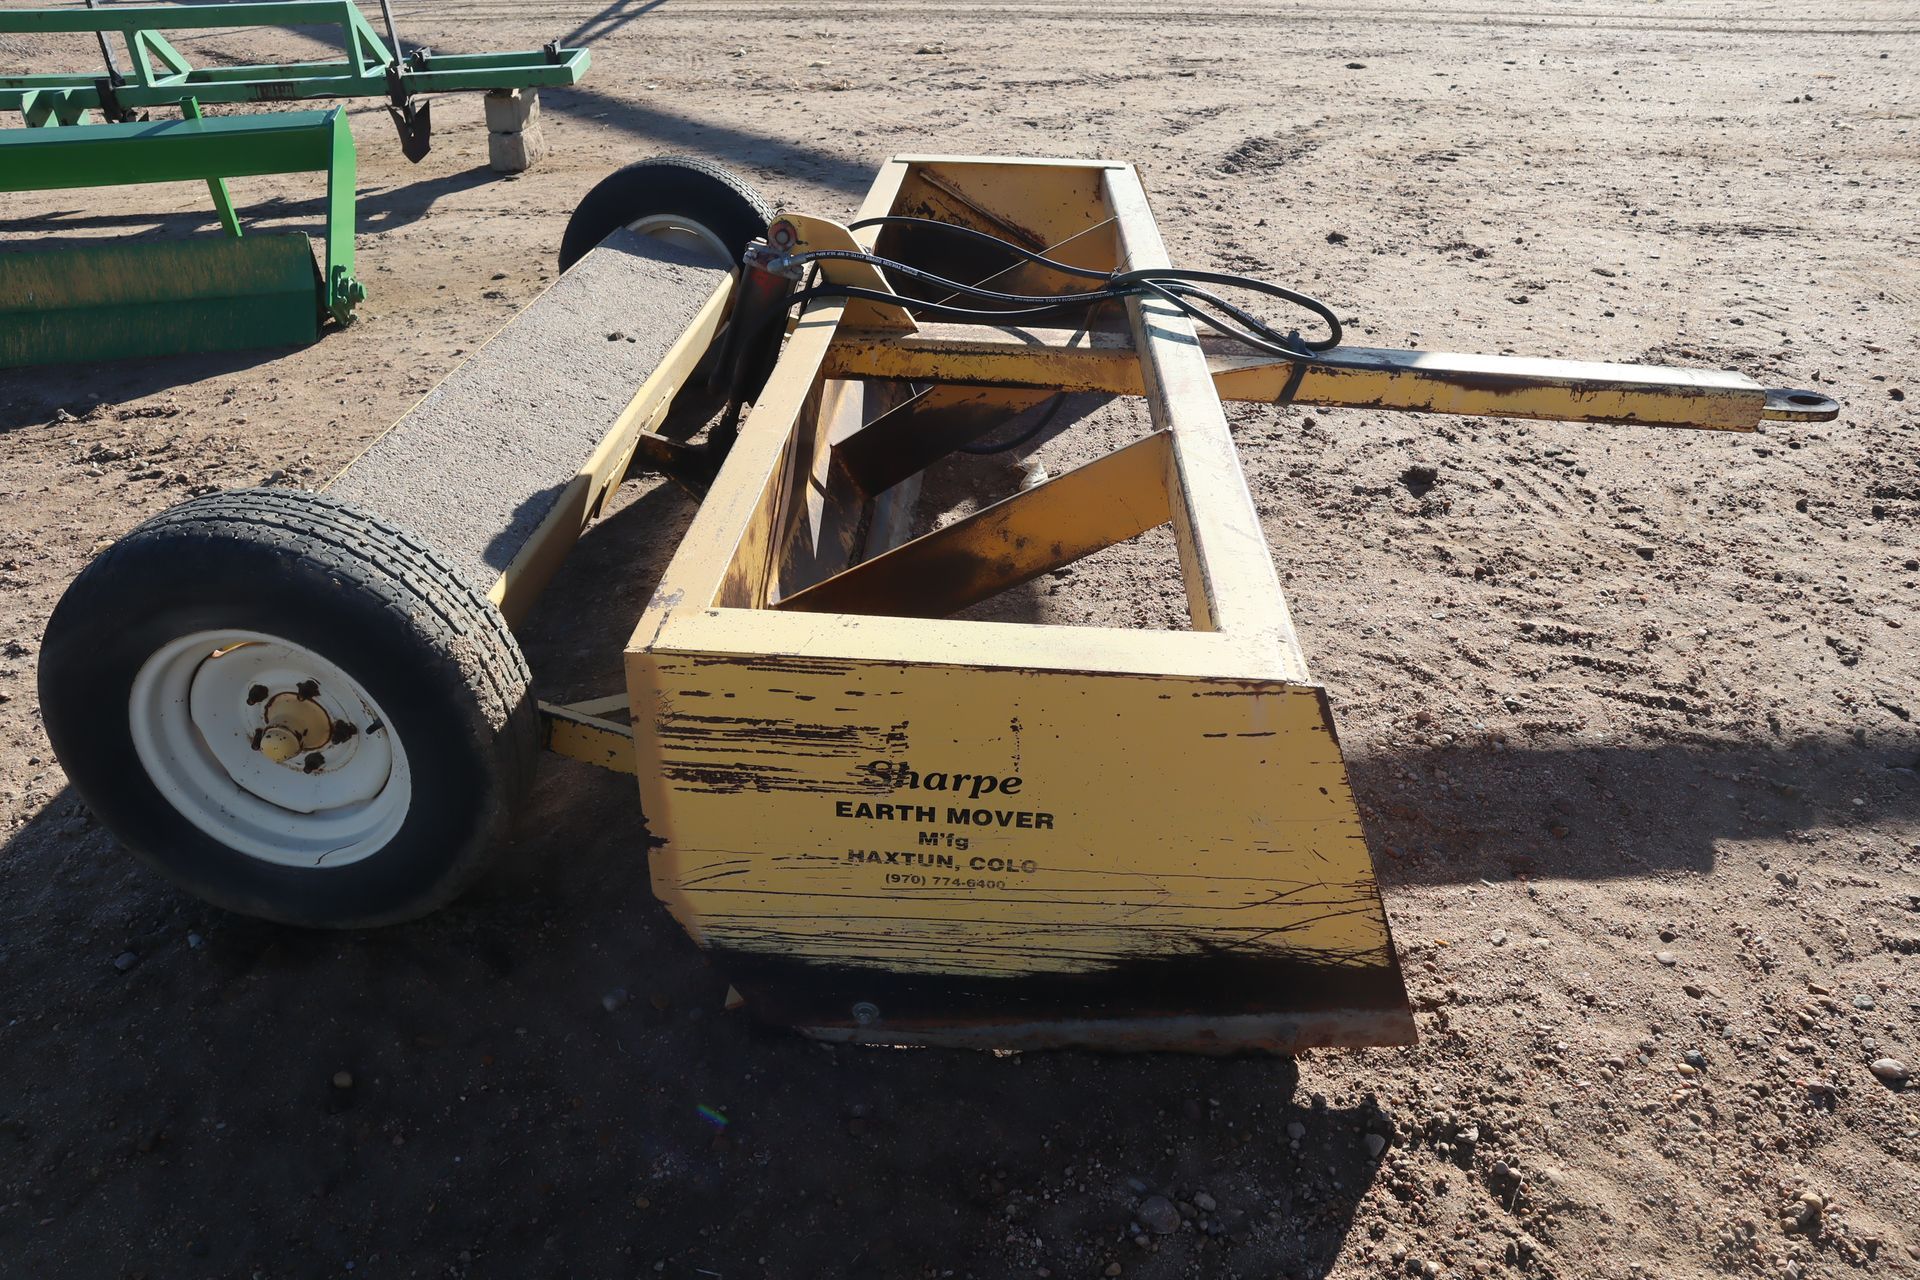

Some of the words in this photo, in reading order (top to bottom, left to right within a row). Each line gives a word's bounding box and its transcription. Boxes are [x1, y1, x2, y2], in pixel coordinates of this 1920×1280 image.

[865, 760, 1023, 799] Sharpe
[835, 801, 936, 823] EARTH
[946, 807, 1055, 830] MOVER
[918, 831, 970, 851] M'fg
[847, 849, 961, 872] HAXTUN,
[885, 873, 926, 887] (970)
[932, 876, 1006, 890] 774-6400
